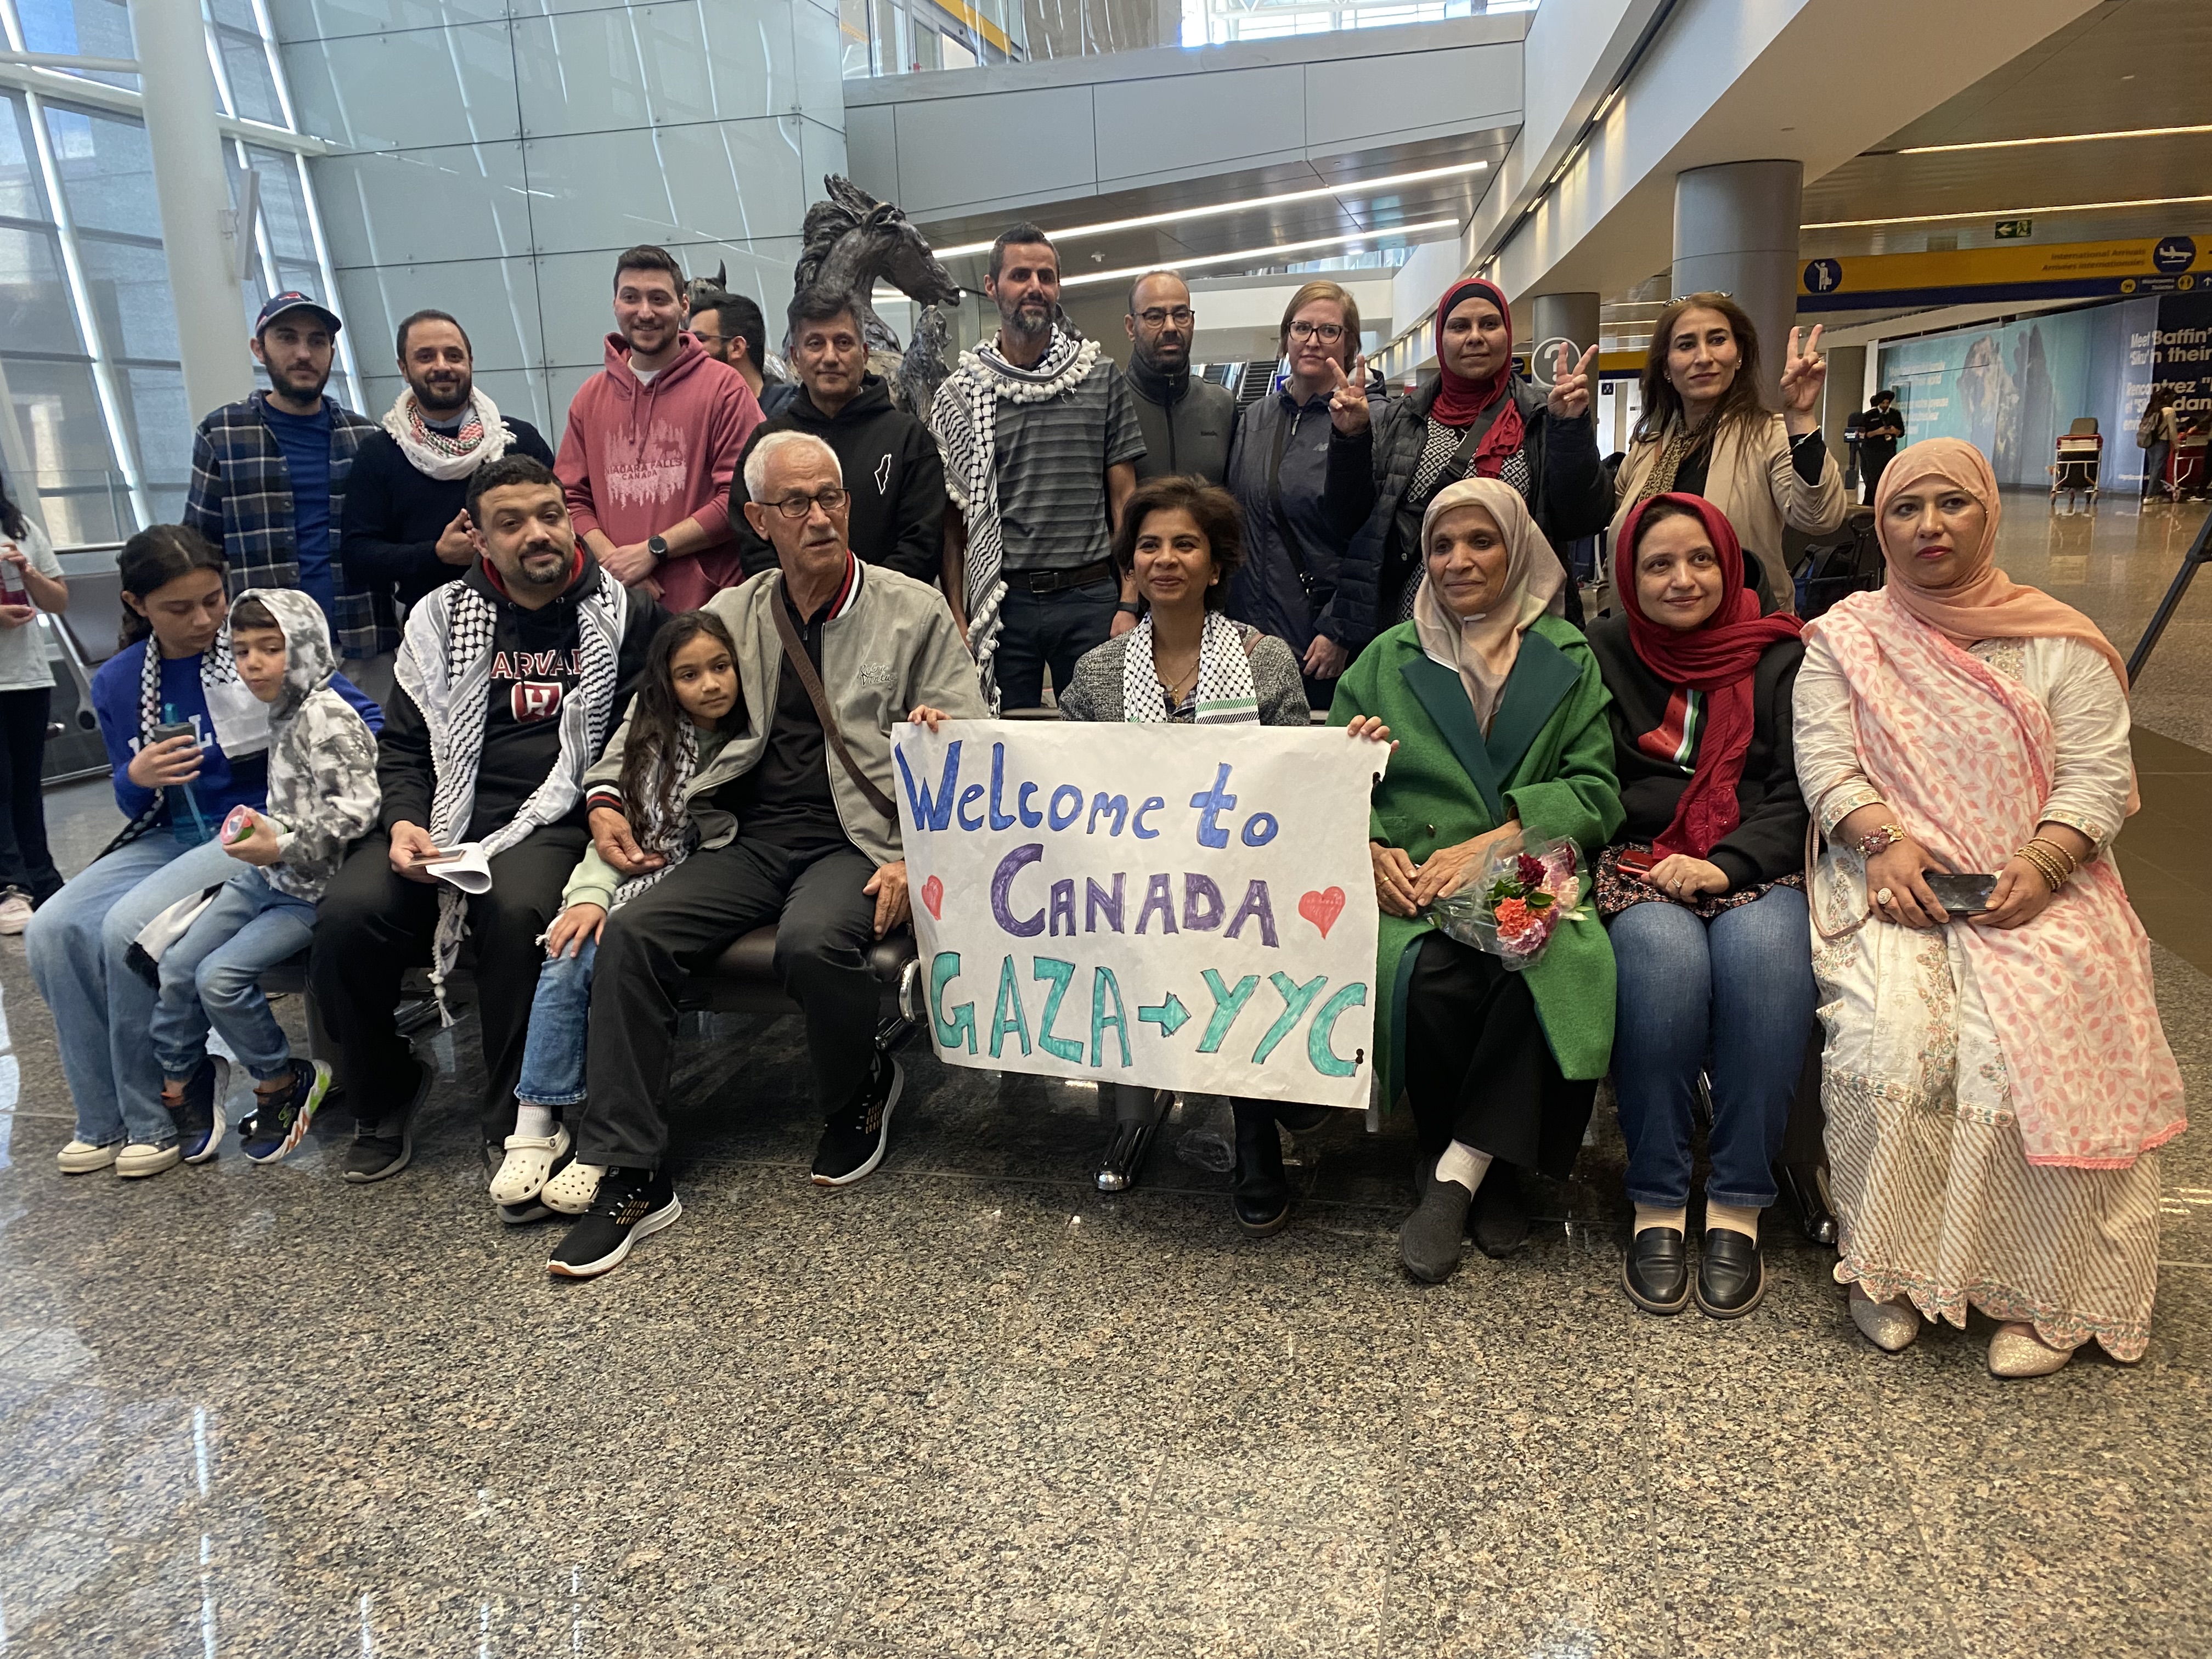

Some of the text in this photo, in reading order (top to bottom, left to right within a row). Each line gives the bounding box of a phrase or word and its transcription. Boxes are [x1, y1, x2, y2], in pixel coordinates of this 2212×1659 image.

[2167, 346, 2212, 363] their
[604, 459, 683, 475] NIAGARA FALLS
[621, 469, 657, 481] CANADA
[894, 740, 1165, 839] Welcome
[1189, 762, 1278, 849] to
[990, 843, 1279, 947] CANADA
[930, 951, 1367, 1076] GAZA YYC
